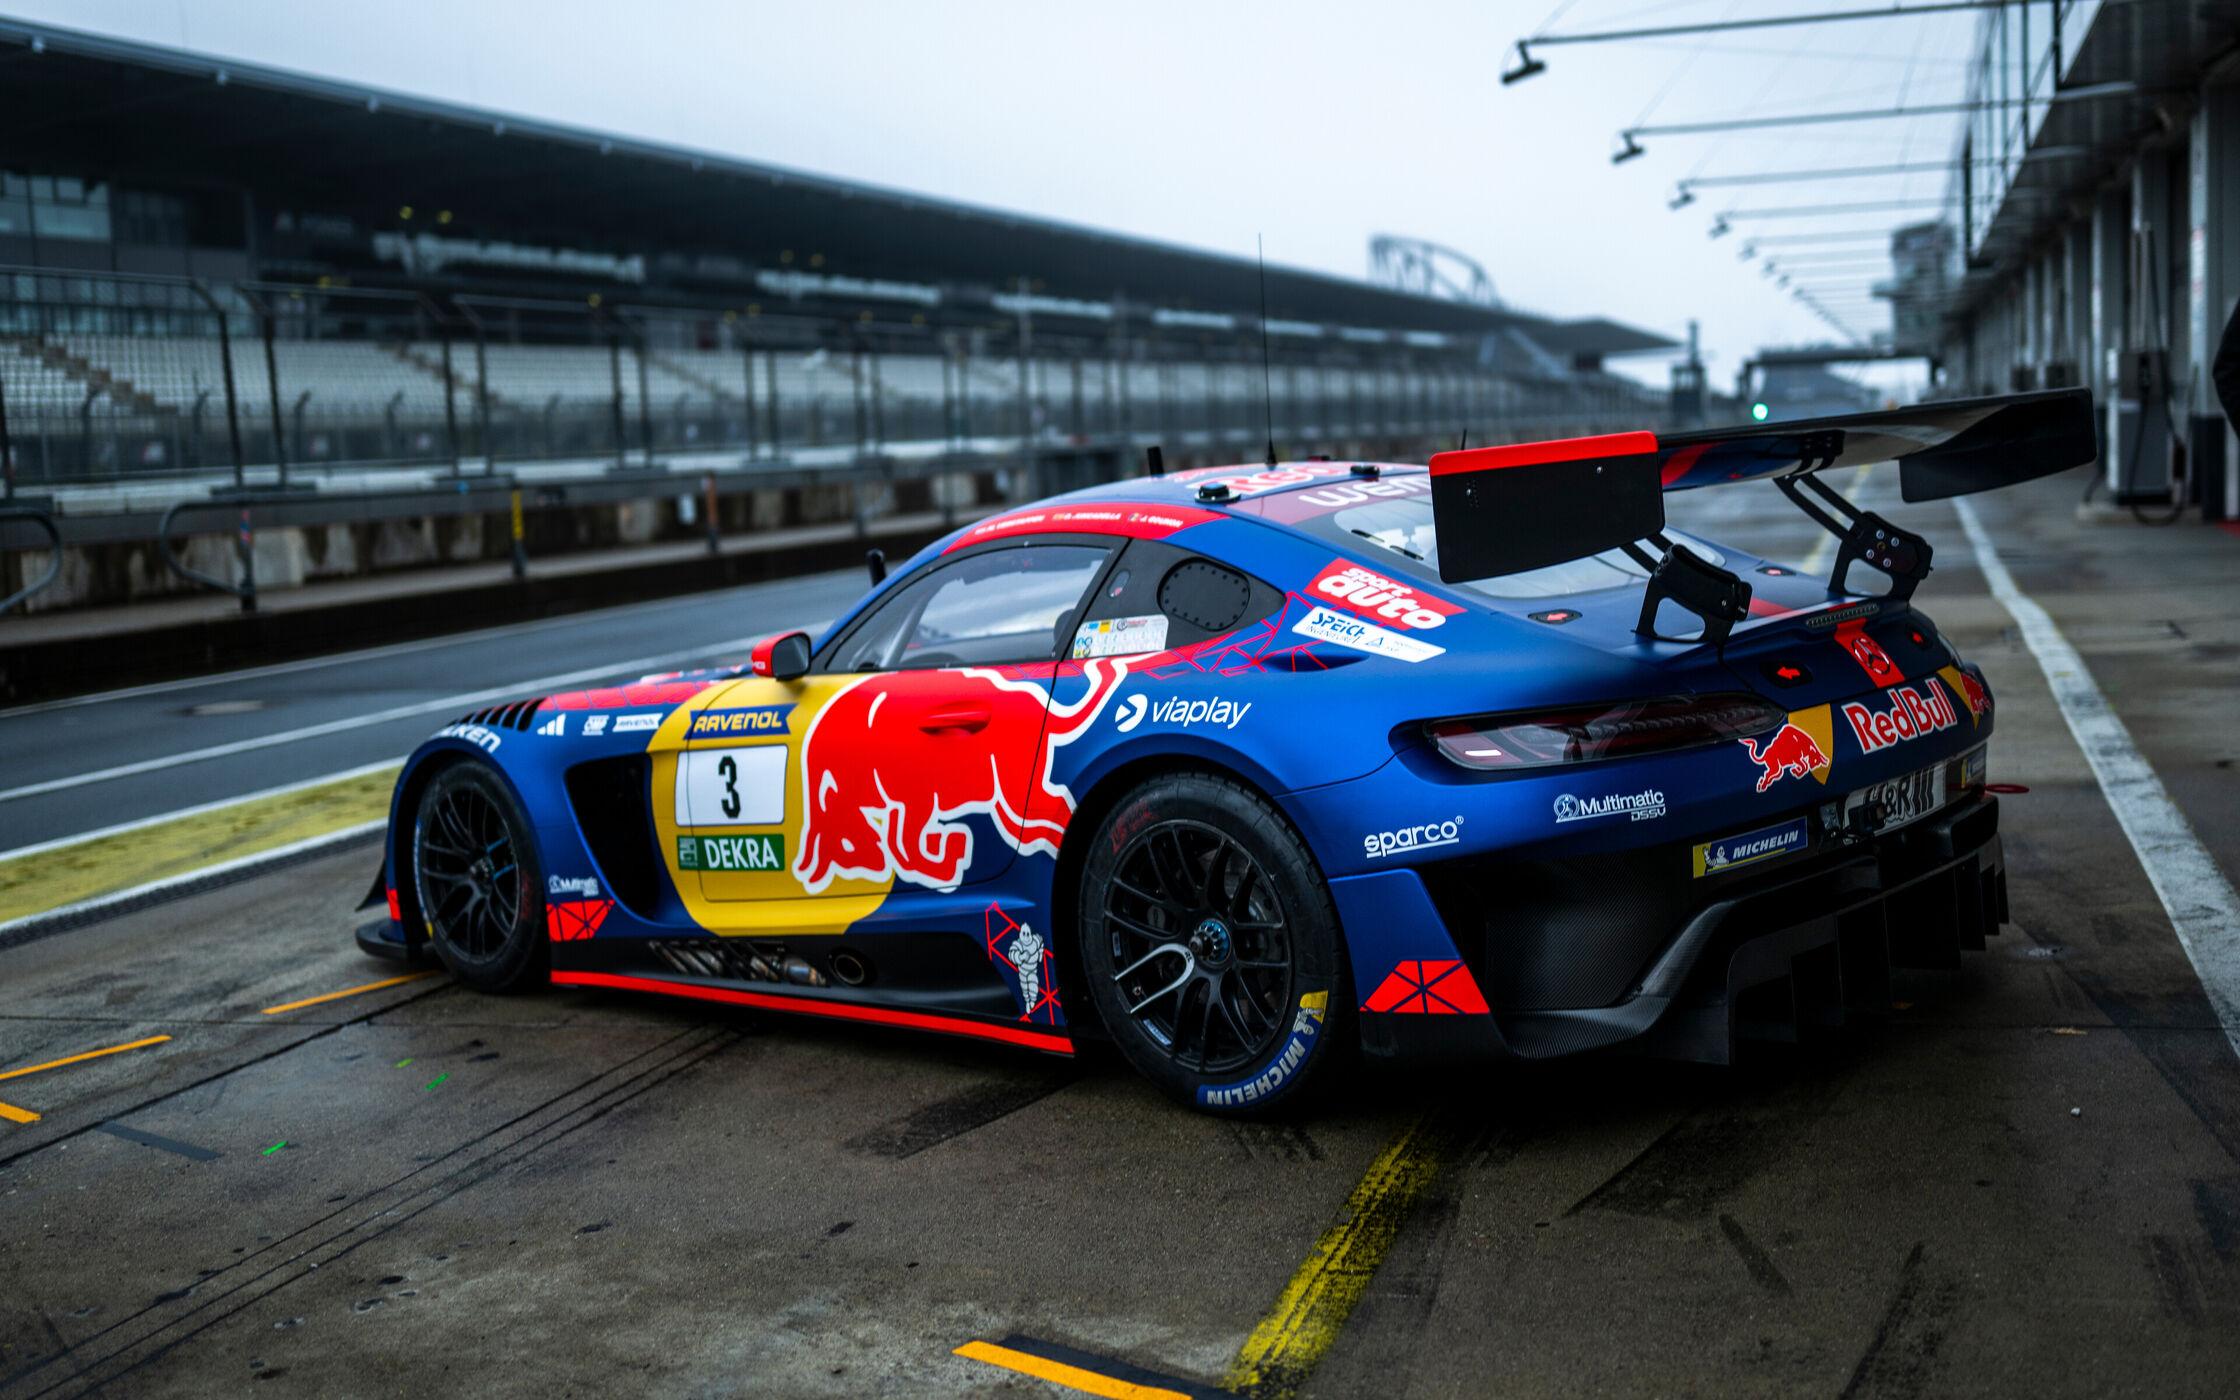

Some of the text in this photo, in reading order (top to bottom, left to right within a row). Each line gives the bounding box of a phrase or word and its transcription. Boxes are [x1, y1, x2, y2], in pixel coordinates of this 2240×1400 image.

[1318, 575, 1446, 629] auto
[693, 711, 782, 733] RAVENOL
[1152, 696, 1251, 729] viaplay
[1841, 677, 1957, 755] Red Bull
[718, 755, 741, 819] 3
[1579, 789, 1665, 816] Multimatic
[1631, 807, 1666, 821] DSSV
[704, 837, 780, 868] DEKRA
[1733, 830, 1799, 859] MICHELIN
[1206, 1037, 1306, 1105] MICHELIN
